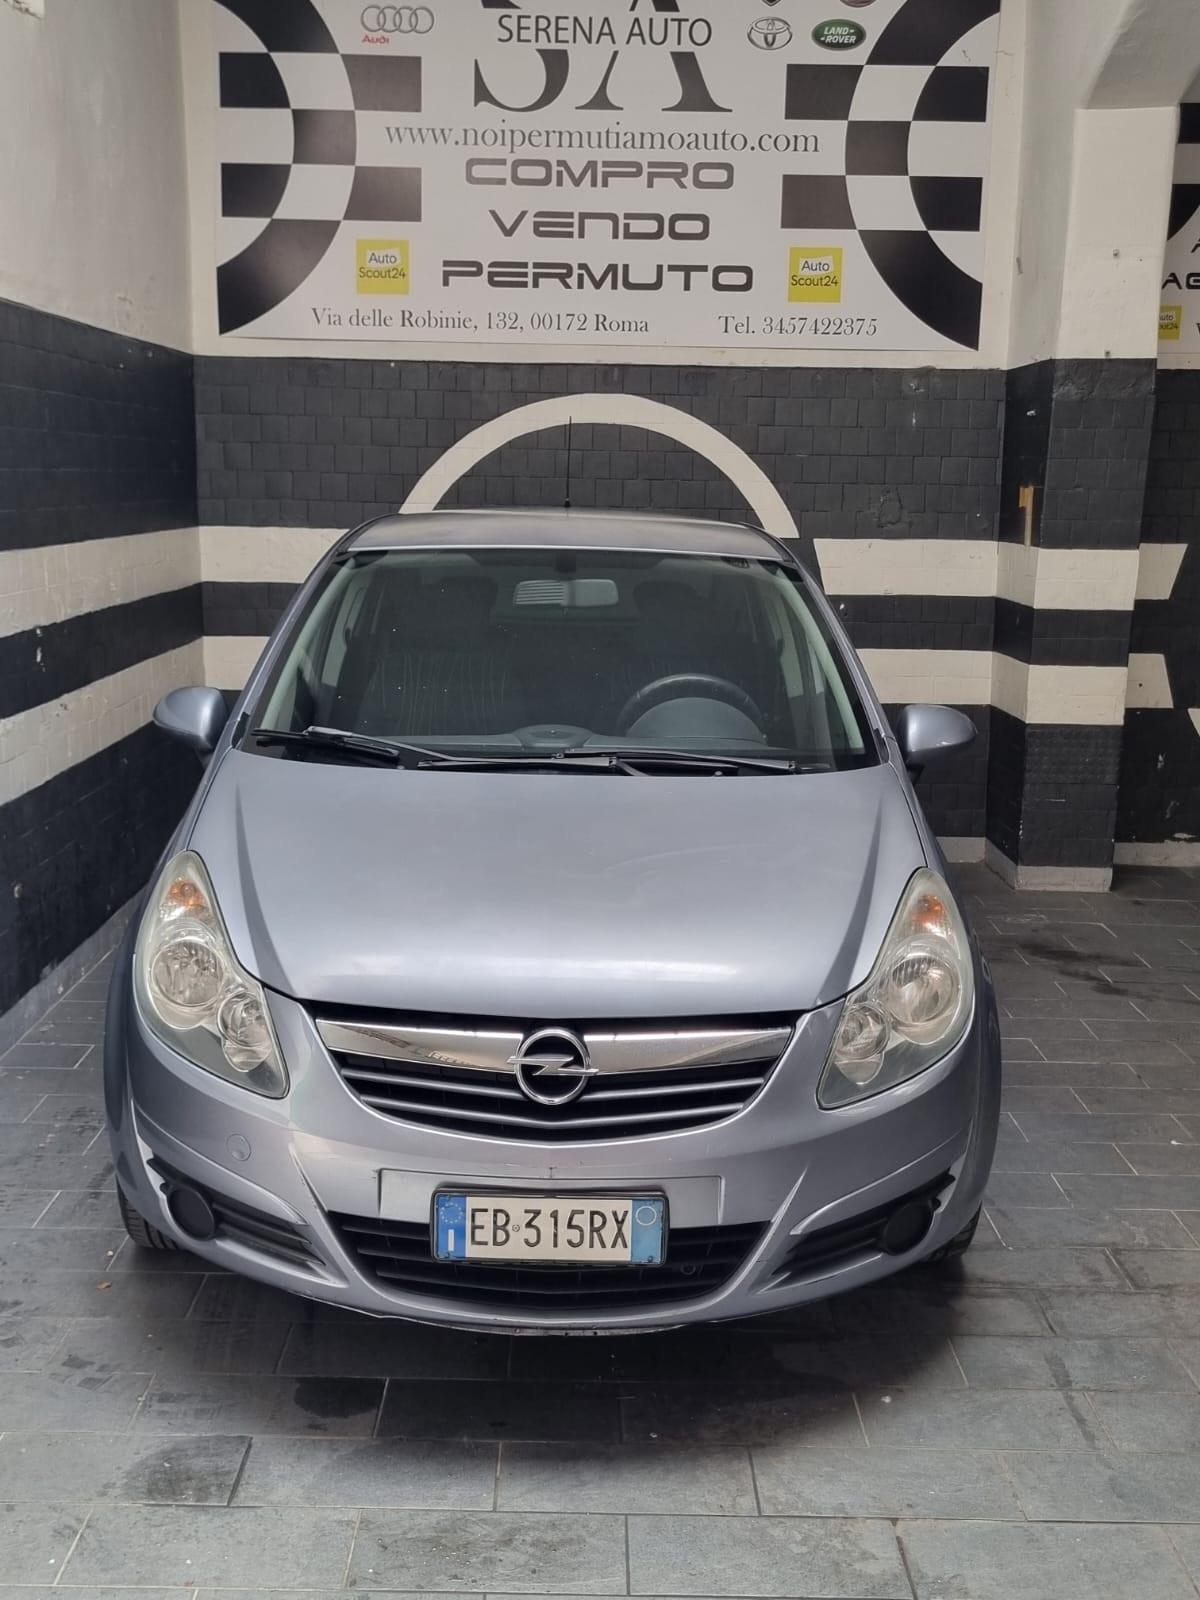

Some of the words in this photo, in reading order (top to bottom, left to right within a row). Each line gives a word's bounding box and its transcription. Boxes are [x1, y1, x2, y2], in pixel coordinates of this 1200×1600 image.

[361, 35, 390, 44] Audi
[498, 14, 617, 45] SERENA
[626, 17, 712, 46] AUTO
[385, 119, 820, 154] www.noipermutiamoauto.com
[465, 157, 734, 190] COMPRO
[488, 209, 710, 241] VENDO
[368, 252, 397, 264] Auto
[801, 260, 831, 272] Auto
[359, 266, 406, 279] Scout24
[442, 260, 754, 292] PERMUTO
[791, 274, 839, 287] Scout24
[311, 307, 342, 327] Via
[348, 308, 393, 327] delle
[400, 309, 478, 332] Robinie,
[486, 311, 524, 332] 132,
[530, 312, 588, 332] 00172
[594, 313, 649, 333] Roma
[718, 315, 756, 334] Tel.
[762, 316, 878, 336] 3457422375
